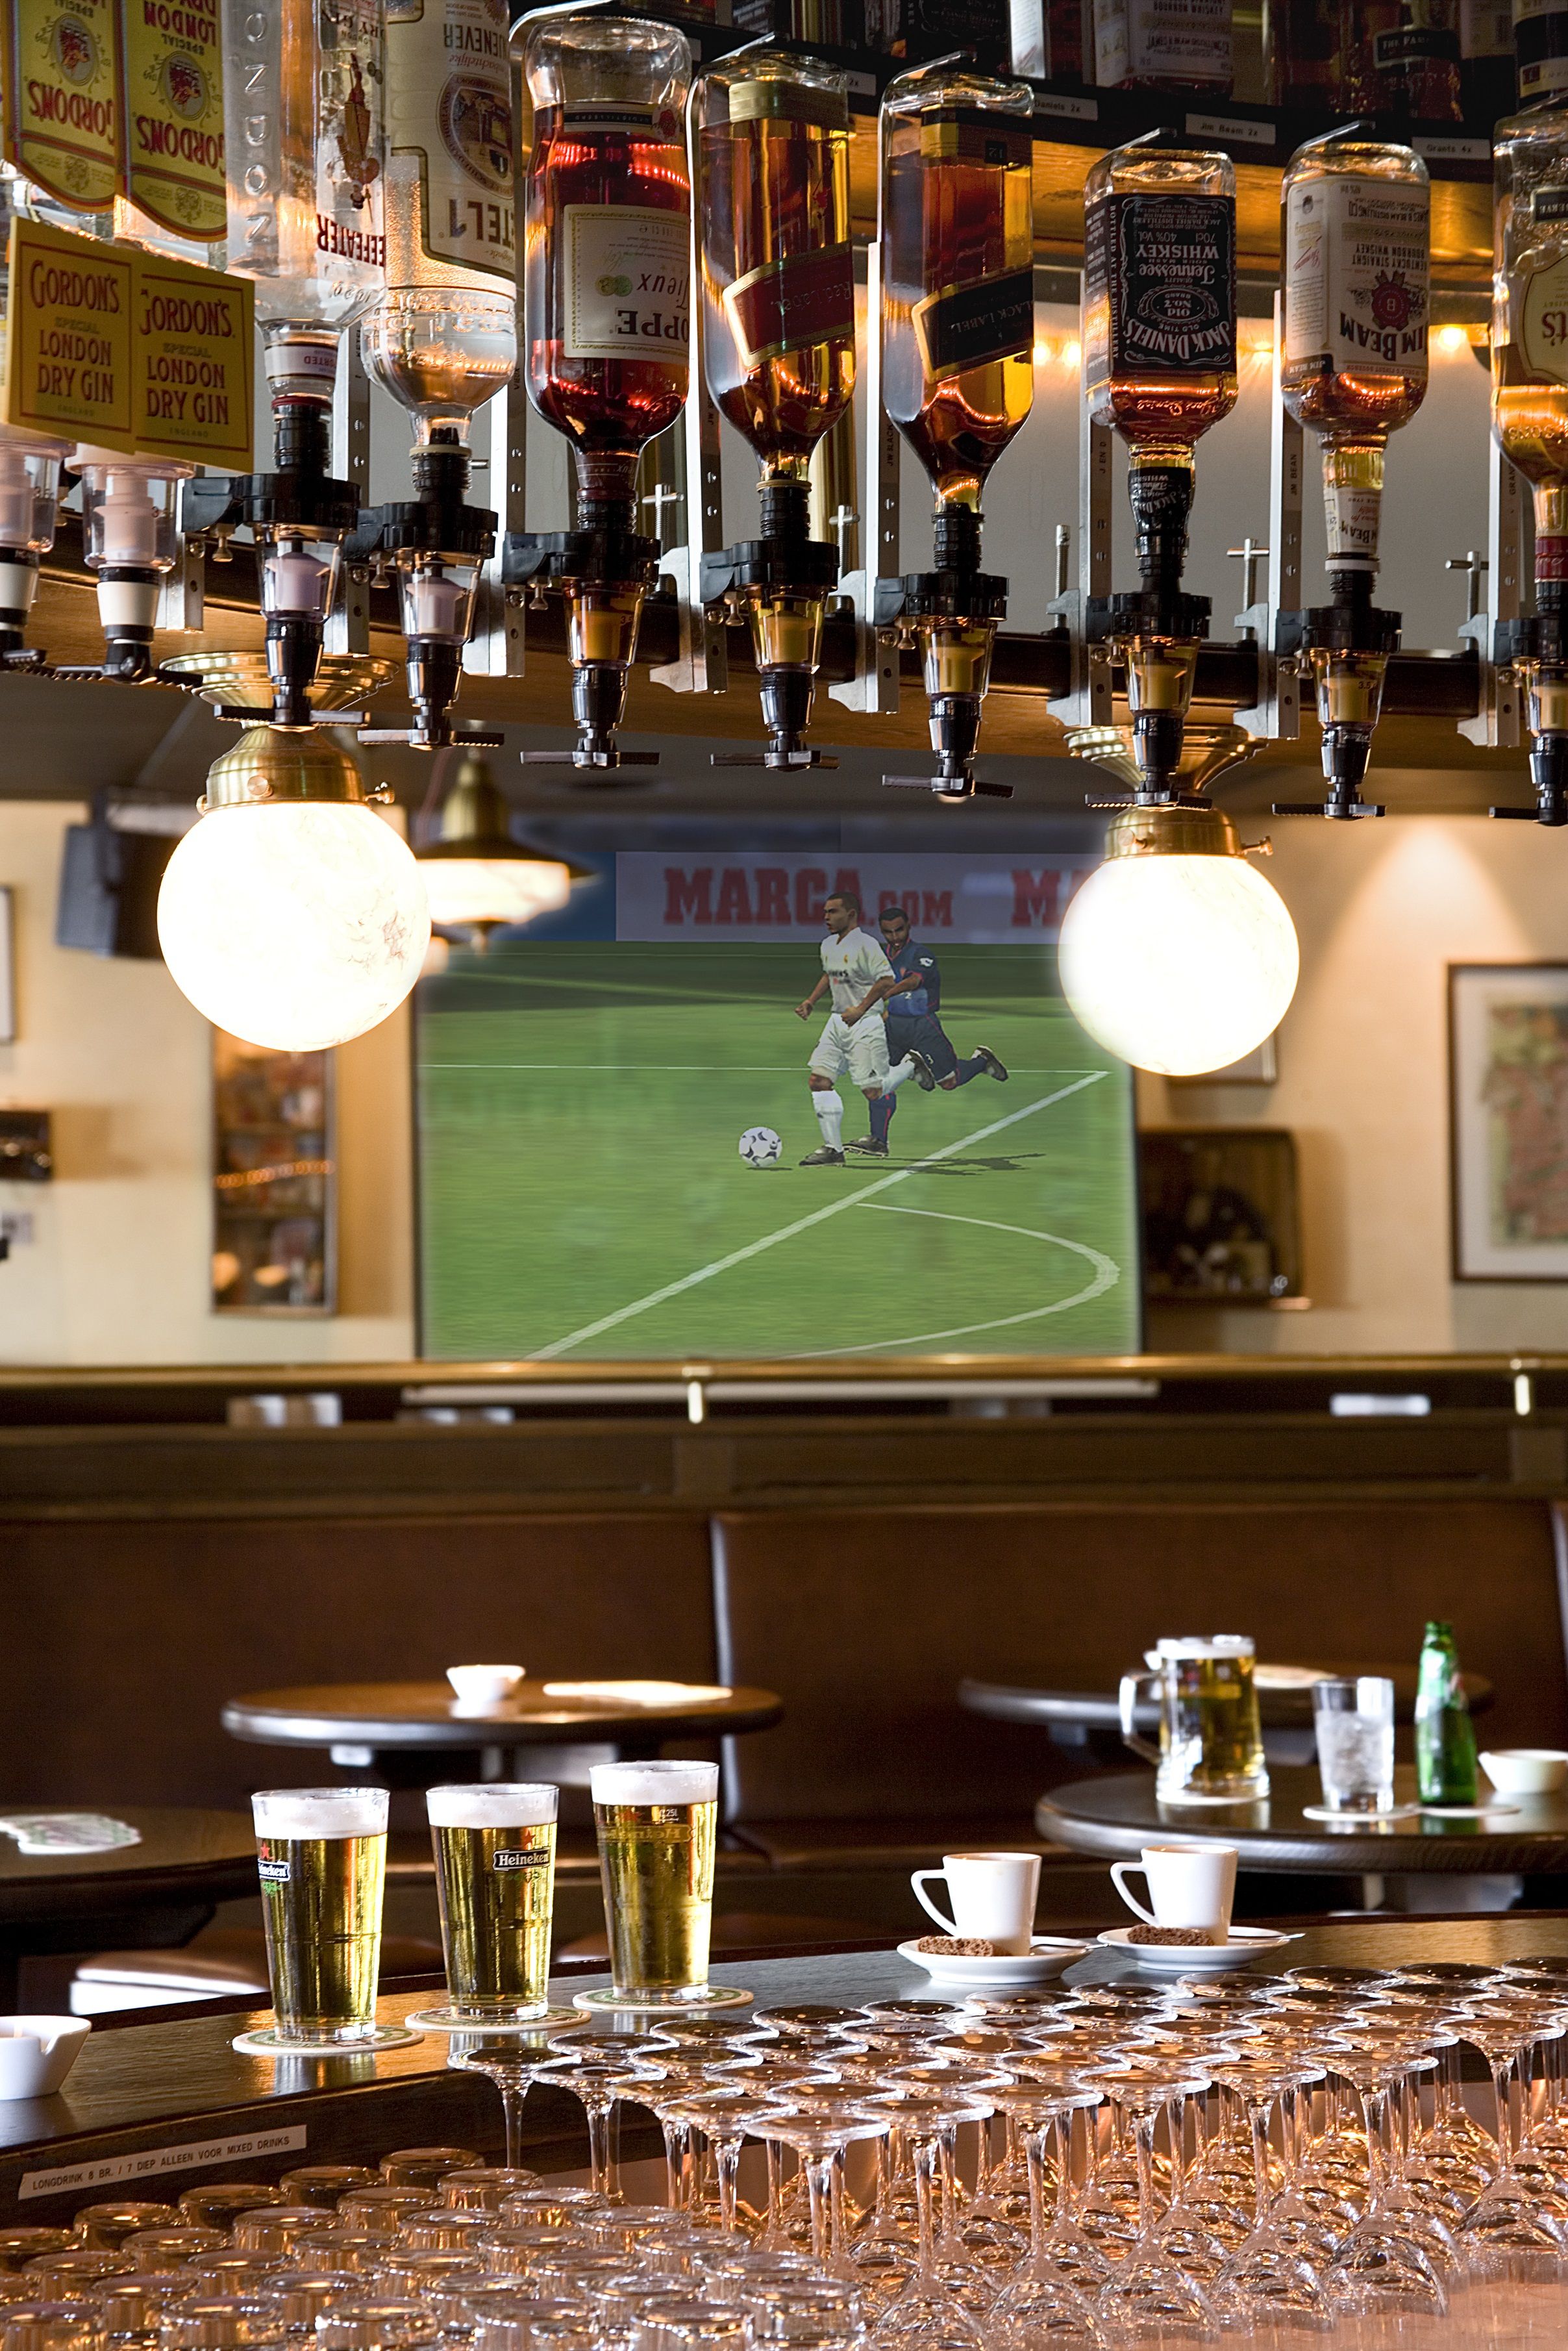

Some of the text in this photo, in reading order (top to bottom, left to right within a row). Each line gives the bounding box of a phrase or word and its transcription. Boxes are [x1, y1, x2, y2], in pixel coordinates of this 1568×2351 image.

[143, 1, 218, 47] LONDON
[161, 34, 205, 56] SPECIAL
[245, 11, 270, 245] ONDON
[1201, 123, 1214, 131] Jim
[1219, 124, 1243, 134] Beam
[317, 214, 386, 268] EEFEATER
[1156, 231, 1178, 242] 40%
[1195, 233, 1217, 244] 70cl
[1135, 244, 1221, 259] WHISKEY
[1356, 243, 1389, 255] WHISKEY
[1352, 254, 1389, 268] STRAIGHT
[1138, 264, 1216, 284] Tennessee
[31, 259, 119, 313] GORDON'S
[997, 299, 1034, 320] LACK
[1166, 308, 1191, 317] Old
[1386, 298, 1396, 312] B
[55, 316, 100, 334] SPECIAL
[617, 309, 690, 344] OPPE
[1158, 323, 1200, 333] OLD TIME
[1122, 318, 1232, 360] JACK DANIEL'S
[1339, 312, 1398, 362] BEAM
[40, 329, 112, 367] LONDON
[162, 342, 212, 358] SPECIAL
[146, 355, 225, 389] LONDON
[1289, 360, 1325, 374] JIM BEAM
[37, 364, 113, 404] DRY GIN
[146, 388, 229, 425] DRY GIN
[1343, 520, 1371, 544] BEAM
[498, 1851, 550, 1867] Heineken
[258, 1863, 287, 1878] eineken
[32, 2172, 83, 2191] LONGDRINK
[88, 2170, 94, 2180] 8
[98, 2166, 114, 2179] BR.
[127, 2163, 134, 2173] 7
[136, 2159, 156, 2172] DIEP
[160, 2152, 194, 2168] ALLEEN
[197, 2148, 223, 2161] VOOR
[226, 2142, 253, 2156] MIXED
[256, 2135, 291, 2150] DRINKS
